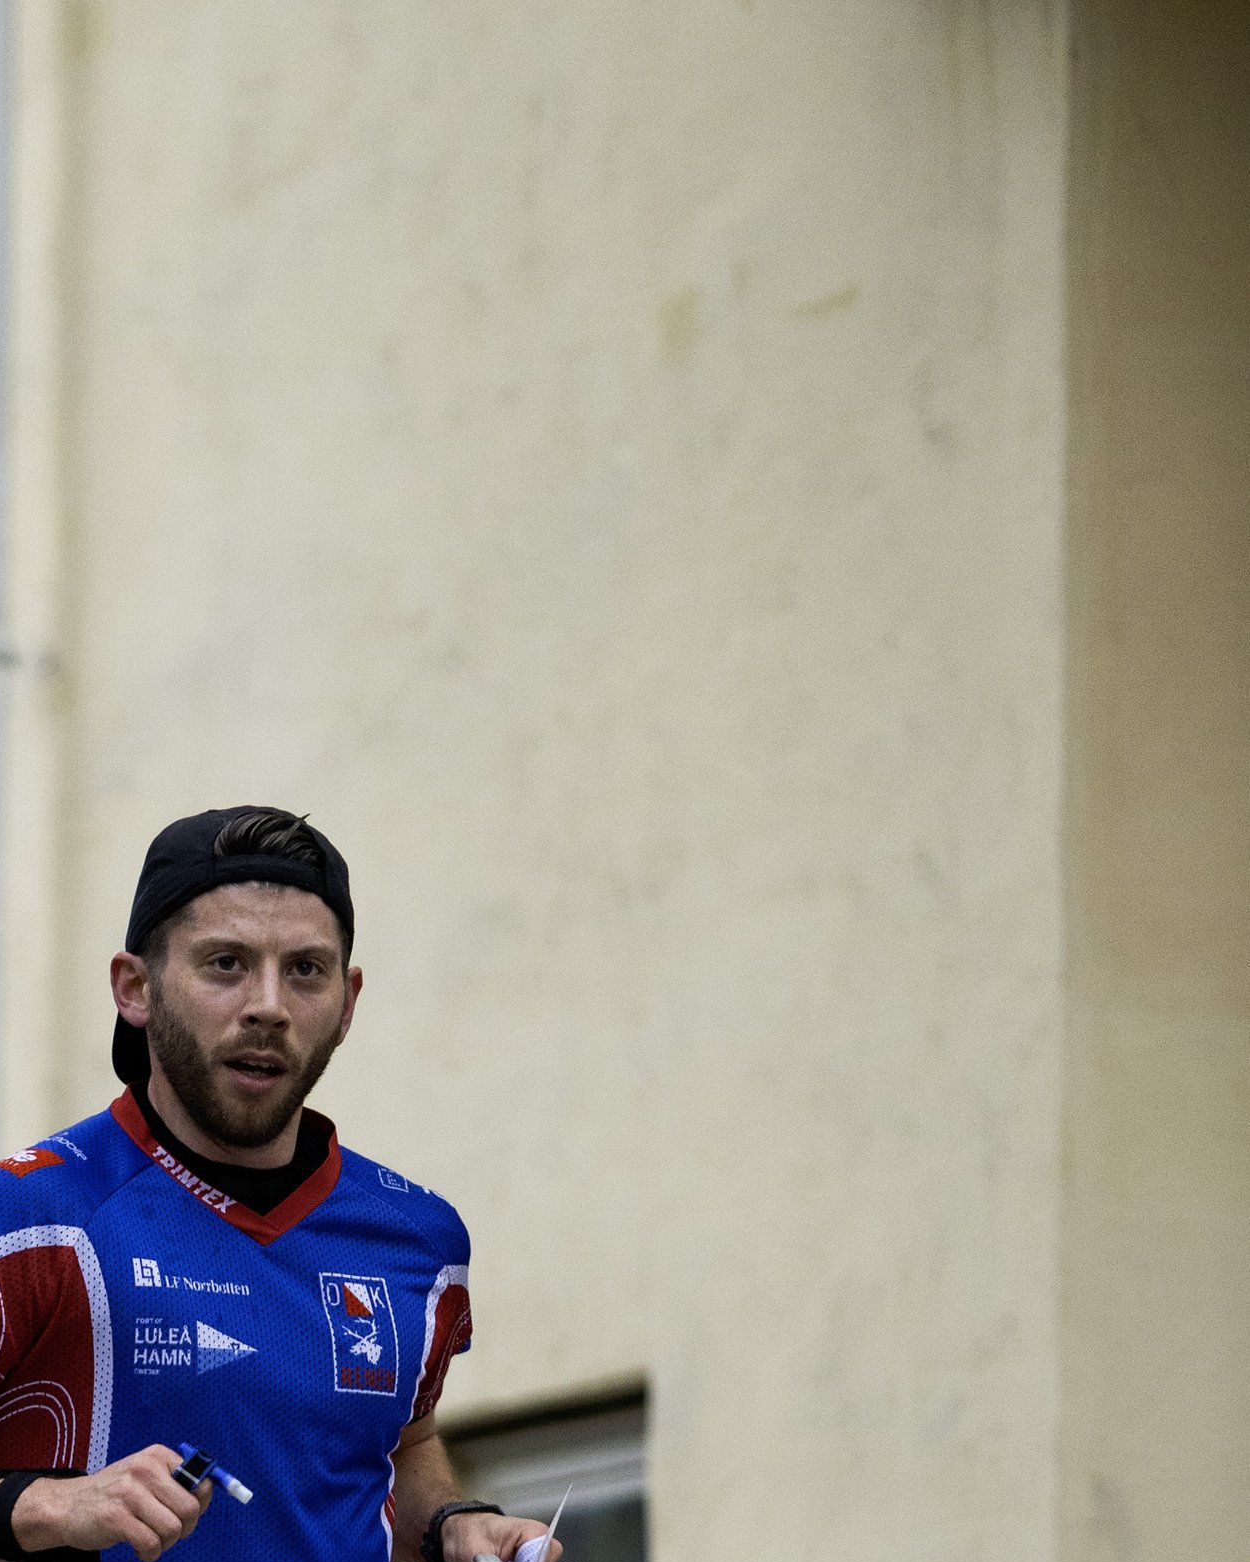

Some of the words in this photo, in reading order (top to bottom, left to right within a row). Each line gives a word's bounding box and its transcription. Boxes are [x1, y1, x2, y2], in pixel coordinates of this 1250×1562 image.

[152, 1145, 237, 1214] TRIMTEX
[183, 1277, 250, 1296] Norrbotten
[326, 1282, 340, 1306] O
[369, 1286, 385, 1308] K
[135, 1325, 192, 1345] LULEÅ
[134, 1348, 191, 1366] HAMN
[341, 1366, 395, 1391] RENEN
